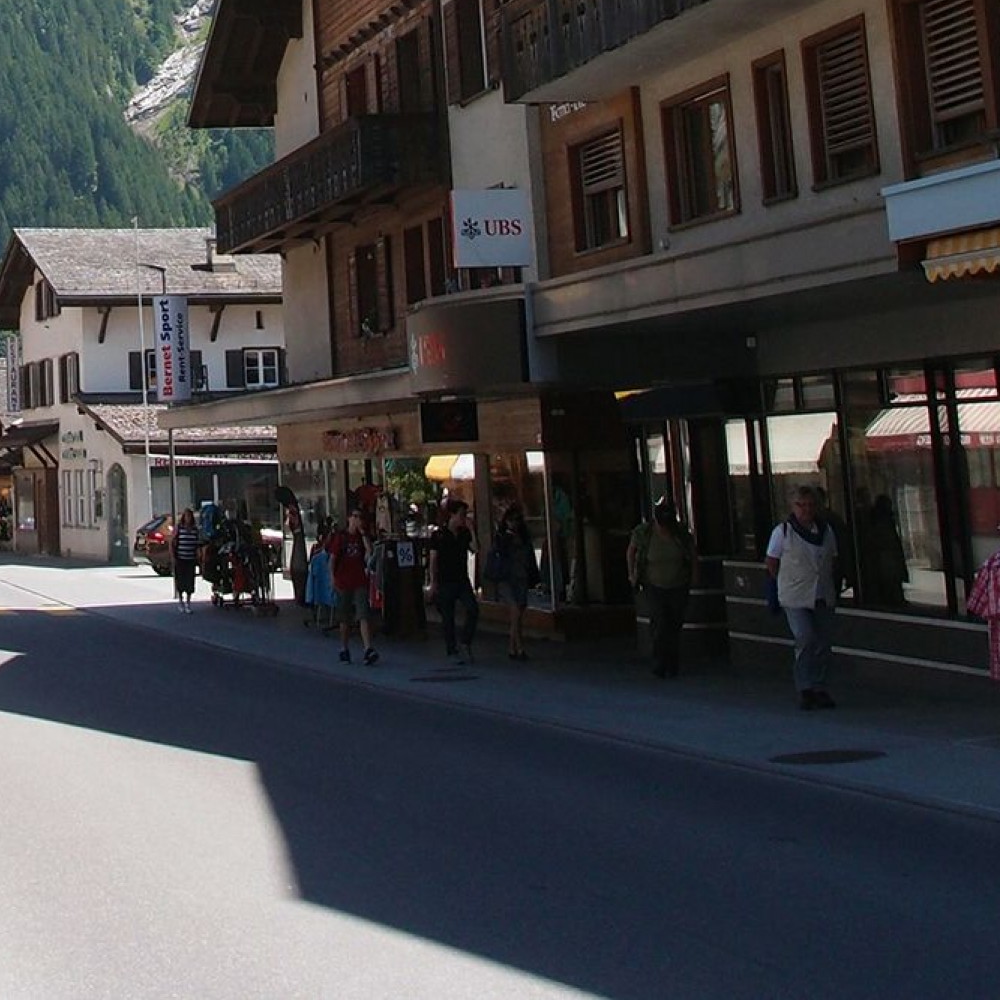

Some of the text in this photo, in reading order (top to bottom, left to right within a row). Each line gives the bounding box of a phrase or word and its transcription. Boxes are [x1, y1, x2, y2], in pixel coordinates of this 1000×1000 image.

[484, 219, 522, 236] UBS
[160, 299, 173, 396] Bernet Sport
[176, 312, 186, 382] Rent-Service
